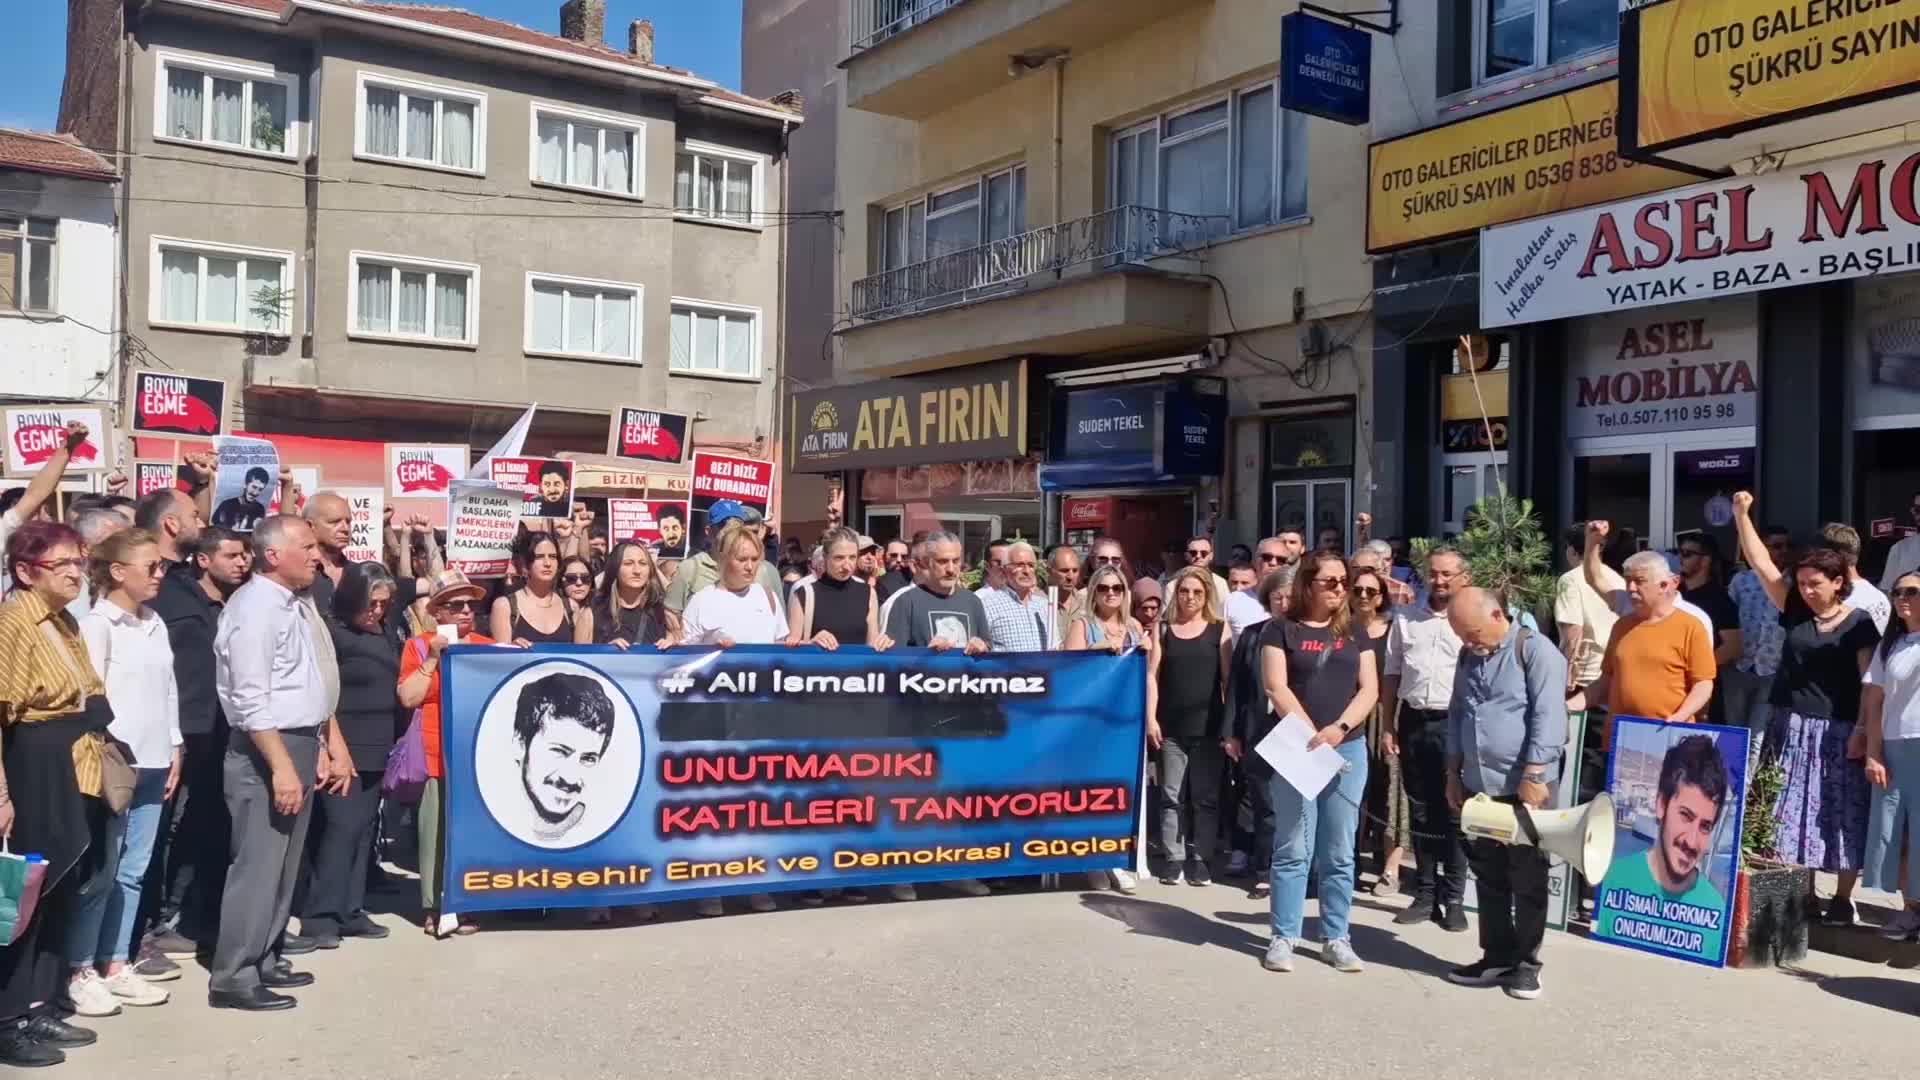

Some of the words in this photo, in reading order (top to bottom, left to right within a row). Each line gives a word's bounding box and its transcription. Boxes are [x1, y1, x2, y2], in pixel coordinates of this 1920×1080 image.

[1694, 25, 1743, 58] OTO
[1729, 36, 1822, 95] ŞÜKRÜ
[1831, 15, 1920, 64] SAYIN
[1382, 167, 1413, 192] OTO
[1417, 139, 1529, 187] GALERİCİLER
[1402, 182, 1458, 222] ŞÜKRÜ
[1463, 173, 1516, 206] SAYIN
[1525, 160, 1574, 191] 0536
[1580, 150, 1617, 179] 838
[1578, 184, 1773, 279] ASEL
[1506, 274, 1545, 319] Halka
[1543, 232, 1578, 270] Satış
[1606, 276, 1687, 306] YATAK
[1713, 262, 1791, 291] BAZA
[1819, 242, 1920, 278] BAŞLI
[1616, 317, 1713, 361] ASEL
[144, 376, 188, 395] BOYUN
[1576, 357, 1760, 408] MOBİLYA
[17, 412, 62, 430] BOYUN
[626, 410, 660, 428] BOYUN
[852, 396, 912, 450] ATA
[919, 380, 1009, 446] FIRIN
[1078, 418, 1112, 434] SUDEM
[1113, 415, 1144, 430] TEKEL
[400, 450, 434, 465] BOYUN
[801, 434, 820, 452] ATA
[823, 431, 848, 450] FIRIN
[468, 496, 481, 505] BU
[483, 498, 509, 507] DAHA
[708, 671, 757, 693] Ali
[899, 672, 1046, 694] Korkmaz
[662, 753, 933, 784] UNUTMADIK!
[662, 796, 875, 833] KATİLLERİ
[892, 787, 1127, 822] TANIYORUZ!
[463, 865, 652, 891] Eskişehir
[666, 856, 766, 881] Emek
[777, 856, 819, 872] ve
[834, 842, 1011, 869] Demokrasi
[1604, 887, 1623, 908] ALİ
[1624, 889, 1663, 919] İSMAİL
[1662, 900, 1720, 930] KORKMAZ
[1614, 916, 1703, 952] ONURUMUZDUR
